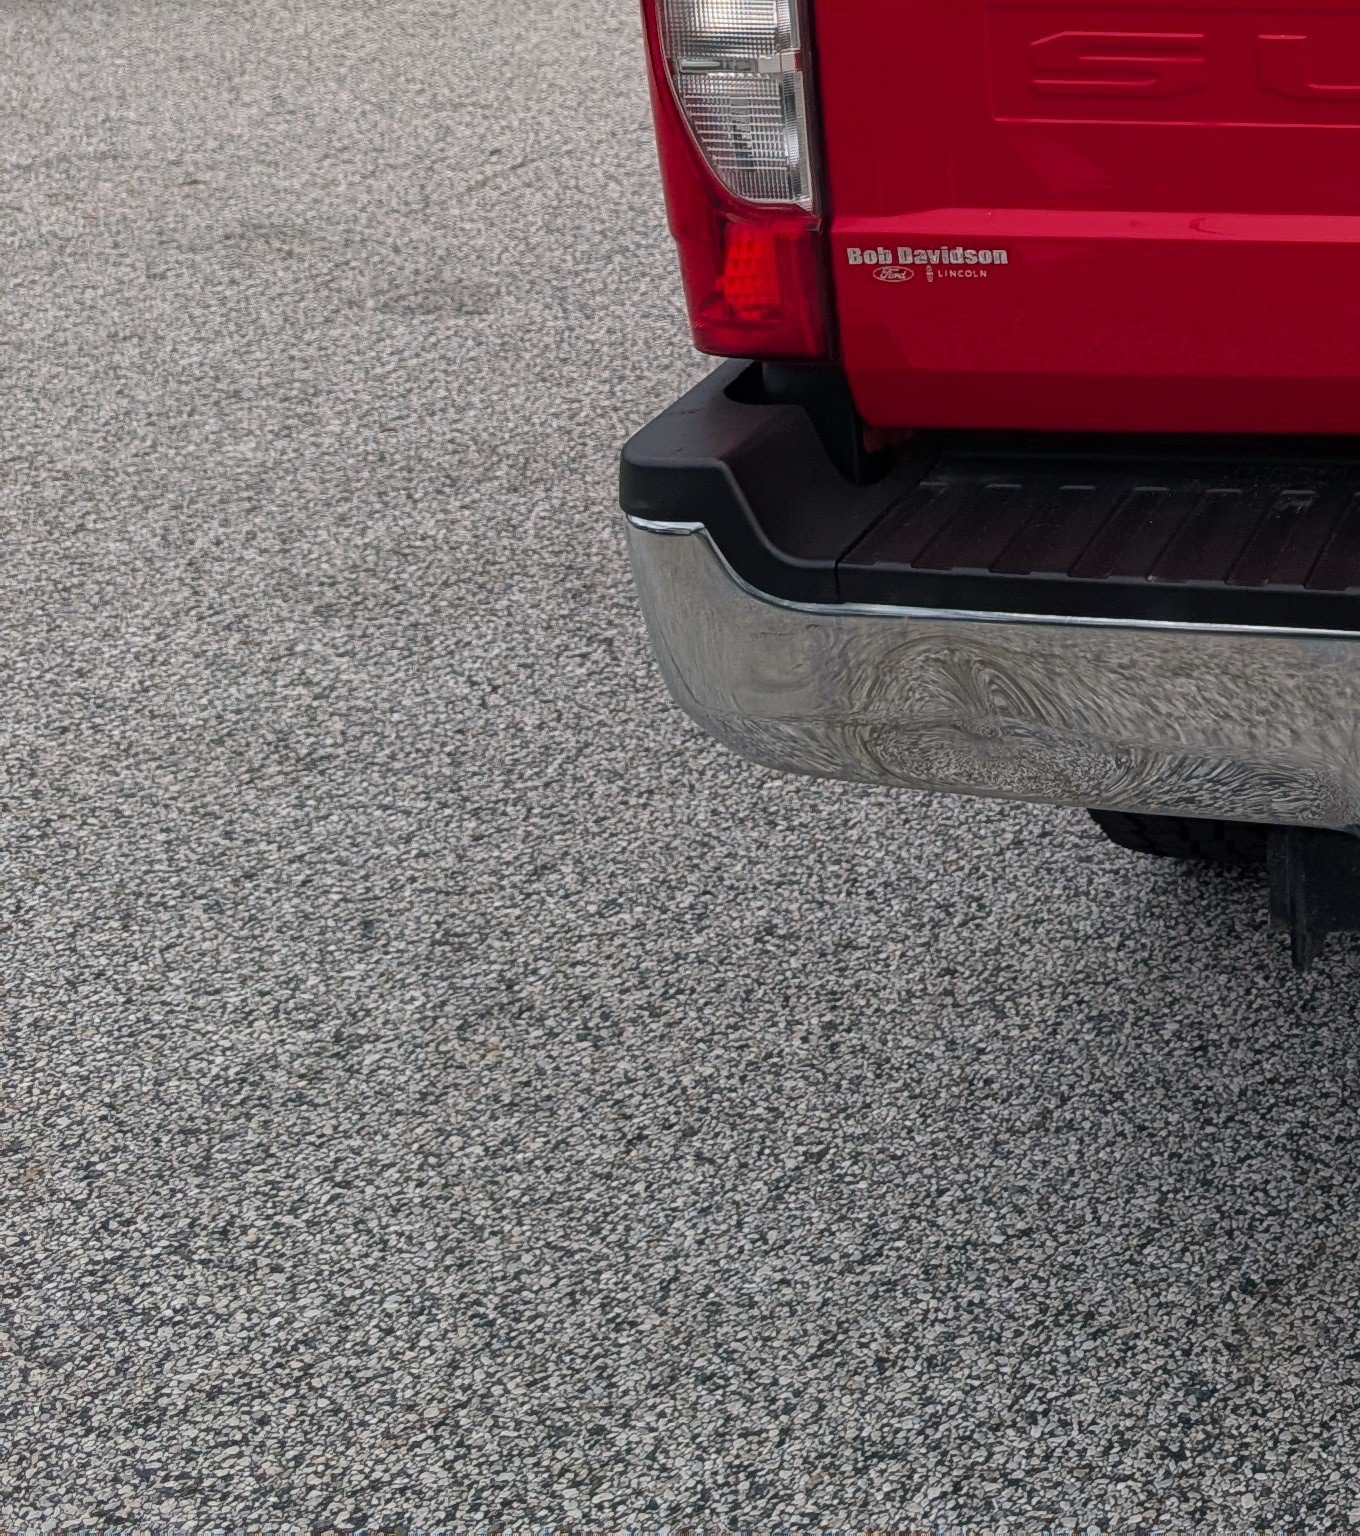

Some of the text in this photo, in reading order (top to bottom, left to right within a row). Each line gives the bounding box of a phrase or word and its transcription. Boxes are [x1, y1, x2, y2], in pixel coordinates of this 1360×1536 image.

[846, 246, 1009, 265] Bob Davidson
[879, 268, 987, 280] Ford LINCOLN
